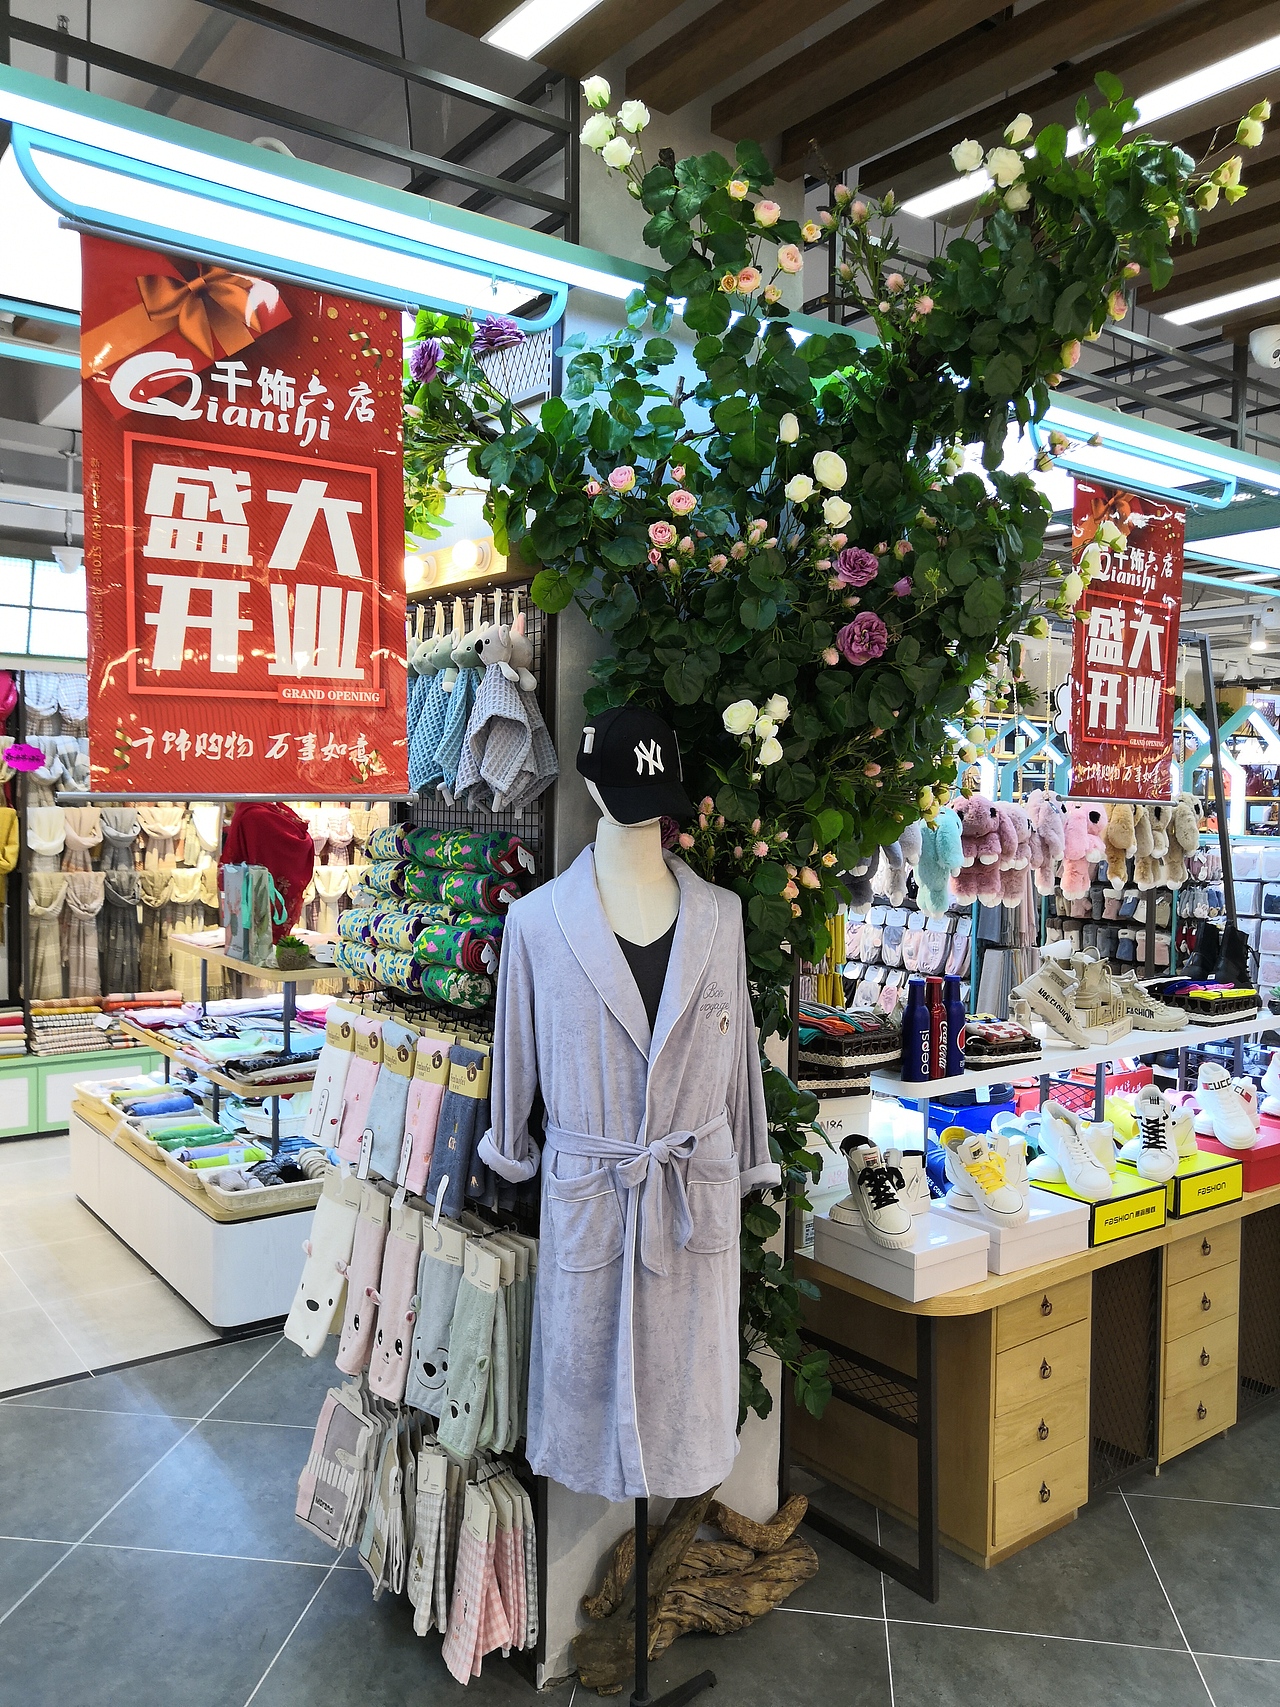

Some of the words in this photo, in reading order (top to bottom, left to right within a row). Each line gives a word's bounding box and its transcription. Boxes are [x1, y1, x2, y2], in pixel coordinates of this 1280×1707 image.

[109, 351, 330, 446] Qianshi
[143, 463, 363, 577] 盛大
[144, 573, 365, 680] 开业
[1087, 606, 1165, 672] 盛大
[281, 687, 325, 701] GRAND
[326, 690, 381, 703] OPENING
[1086, 671, 1162, 734] 开业
[633, 738, 665, 776] NY
[1129, 738, 1146, 747] GRAND
[1146, 739, 1165, 748] OPENING
[919, 1029, 930, 1075] pepsi
